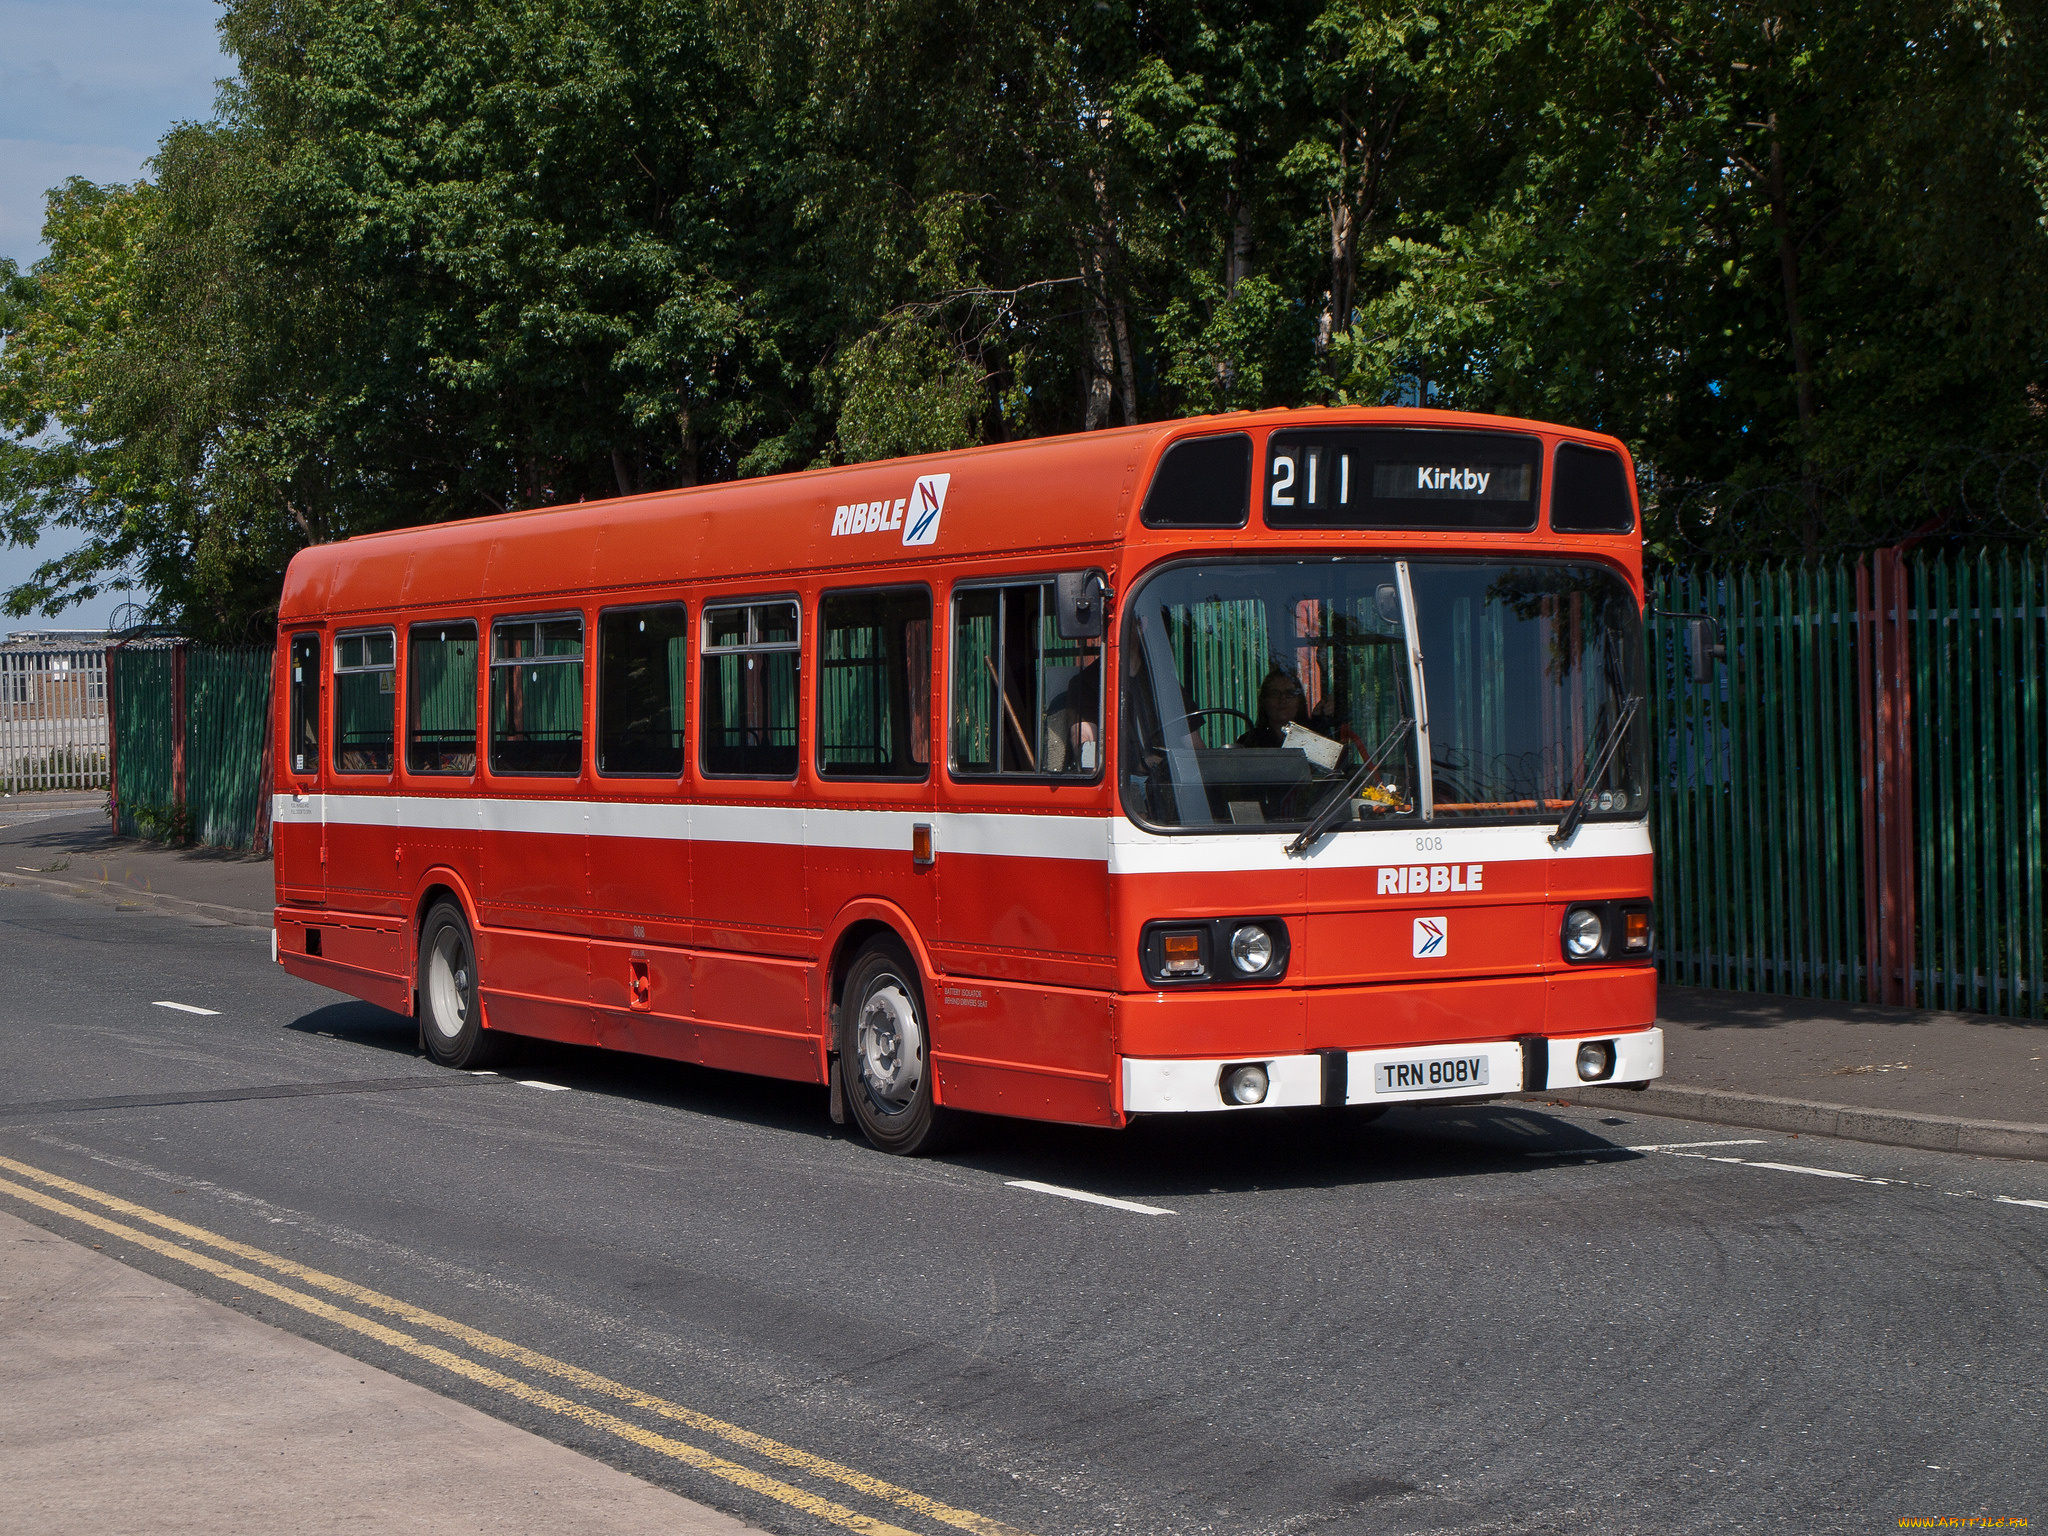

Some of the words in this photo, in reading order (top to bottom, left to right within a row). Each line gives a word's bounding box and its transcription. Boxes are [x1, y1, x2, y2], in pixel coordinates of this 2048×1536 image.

[1271, 454, 1349, 506] 211
[1418, 466, 1490, 494] Kirkby
[831, 498, 906, 536] RIBBLE
[1415, 836, 1443, 852] 808
[1377, 864, 1484, 895] RIBBLE
[633, 925, 645, 938] 808
[944, 988, 961, 996] BATTERY
[961, 989, 982, 998] ISOLATOR
[977, 1000, 988, 1008] SEAT
[1384, 1063, 1423, 1087] TRN
[1429, 1059, 1480, 1084] 808V
